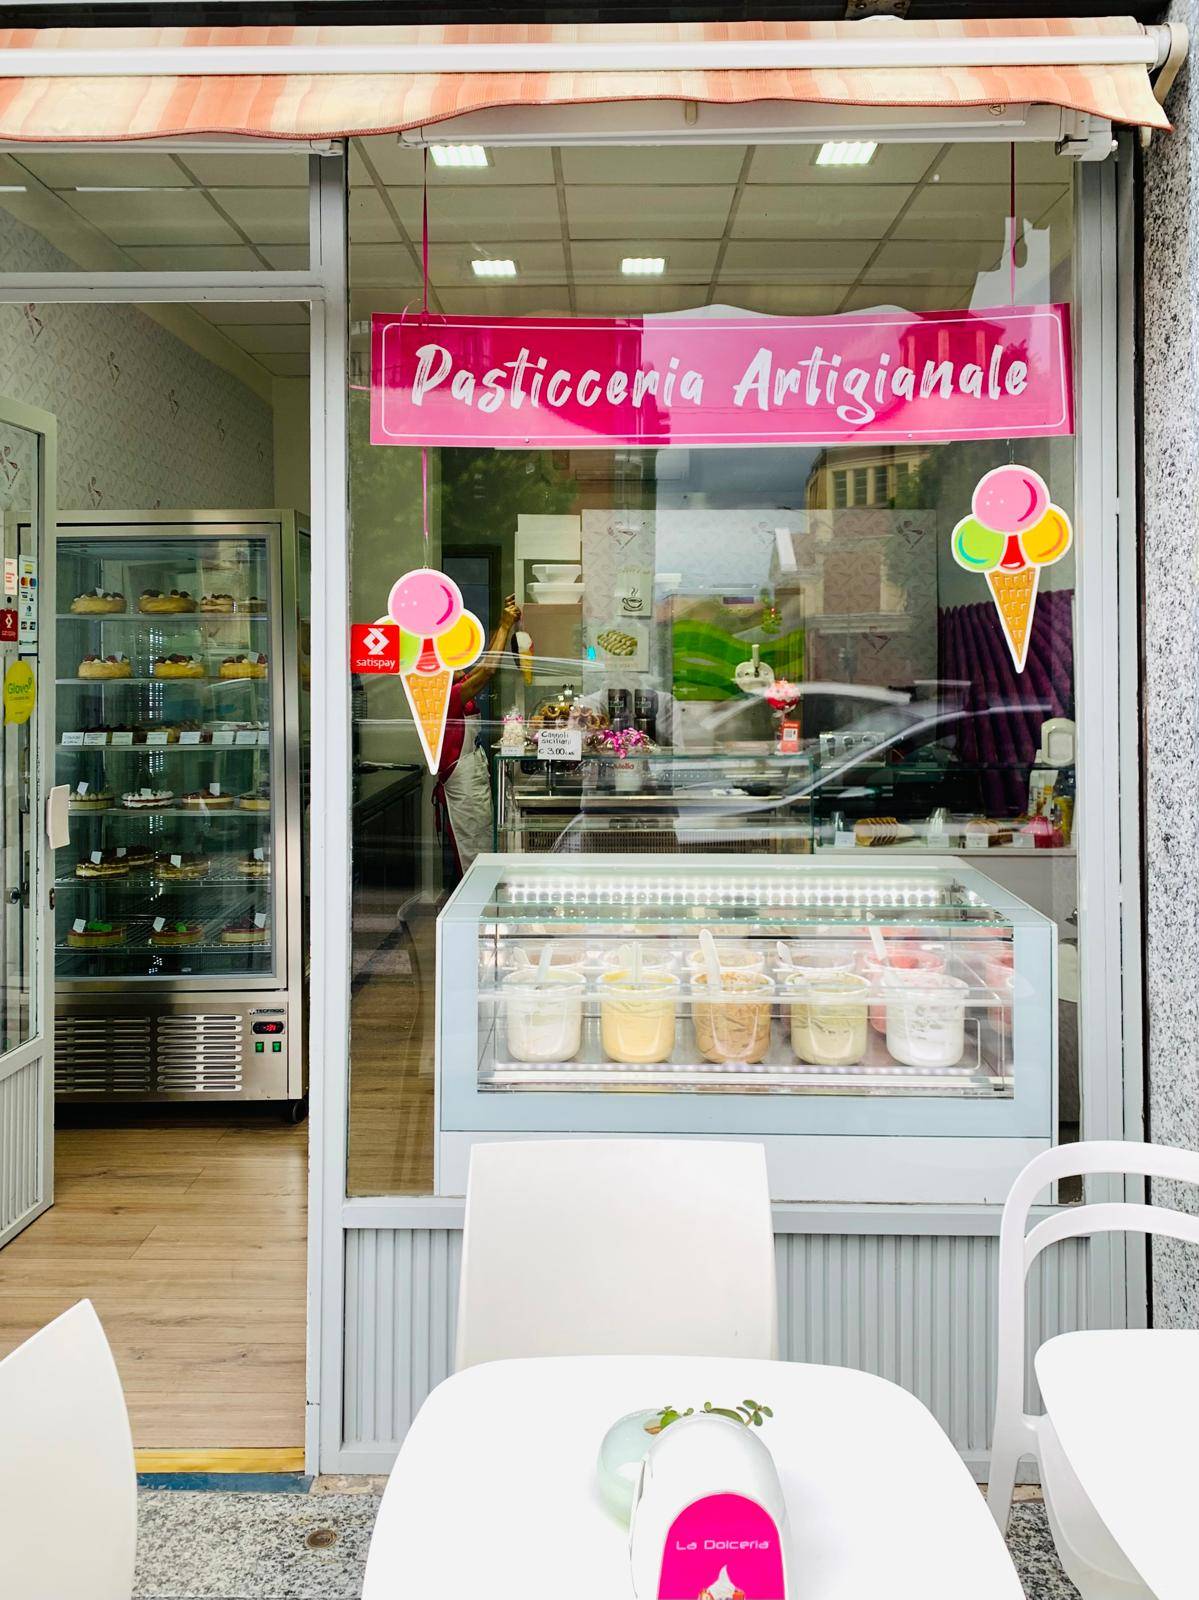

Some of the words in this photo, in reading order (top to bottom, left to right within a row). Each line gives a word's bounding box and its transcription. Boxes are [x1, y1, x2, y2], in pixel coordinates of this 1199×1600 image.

[411, 343, 703, 413] Pasticceria
[732, 343, 1029, 424] Artigianale
[356, 658, 396, 670] satispay
[7, 677, 33, 694] Glovo
[675, 1540, 698, 1551] La
[703, 1539, 770, 1550] Dolceria
